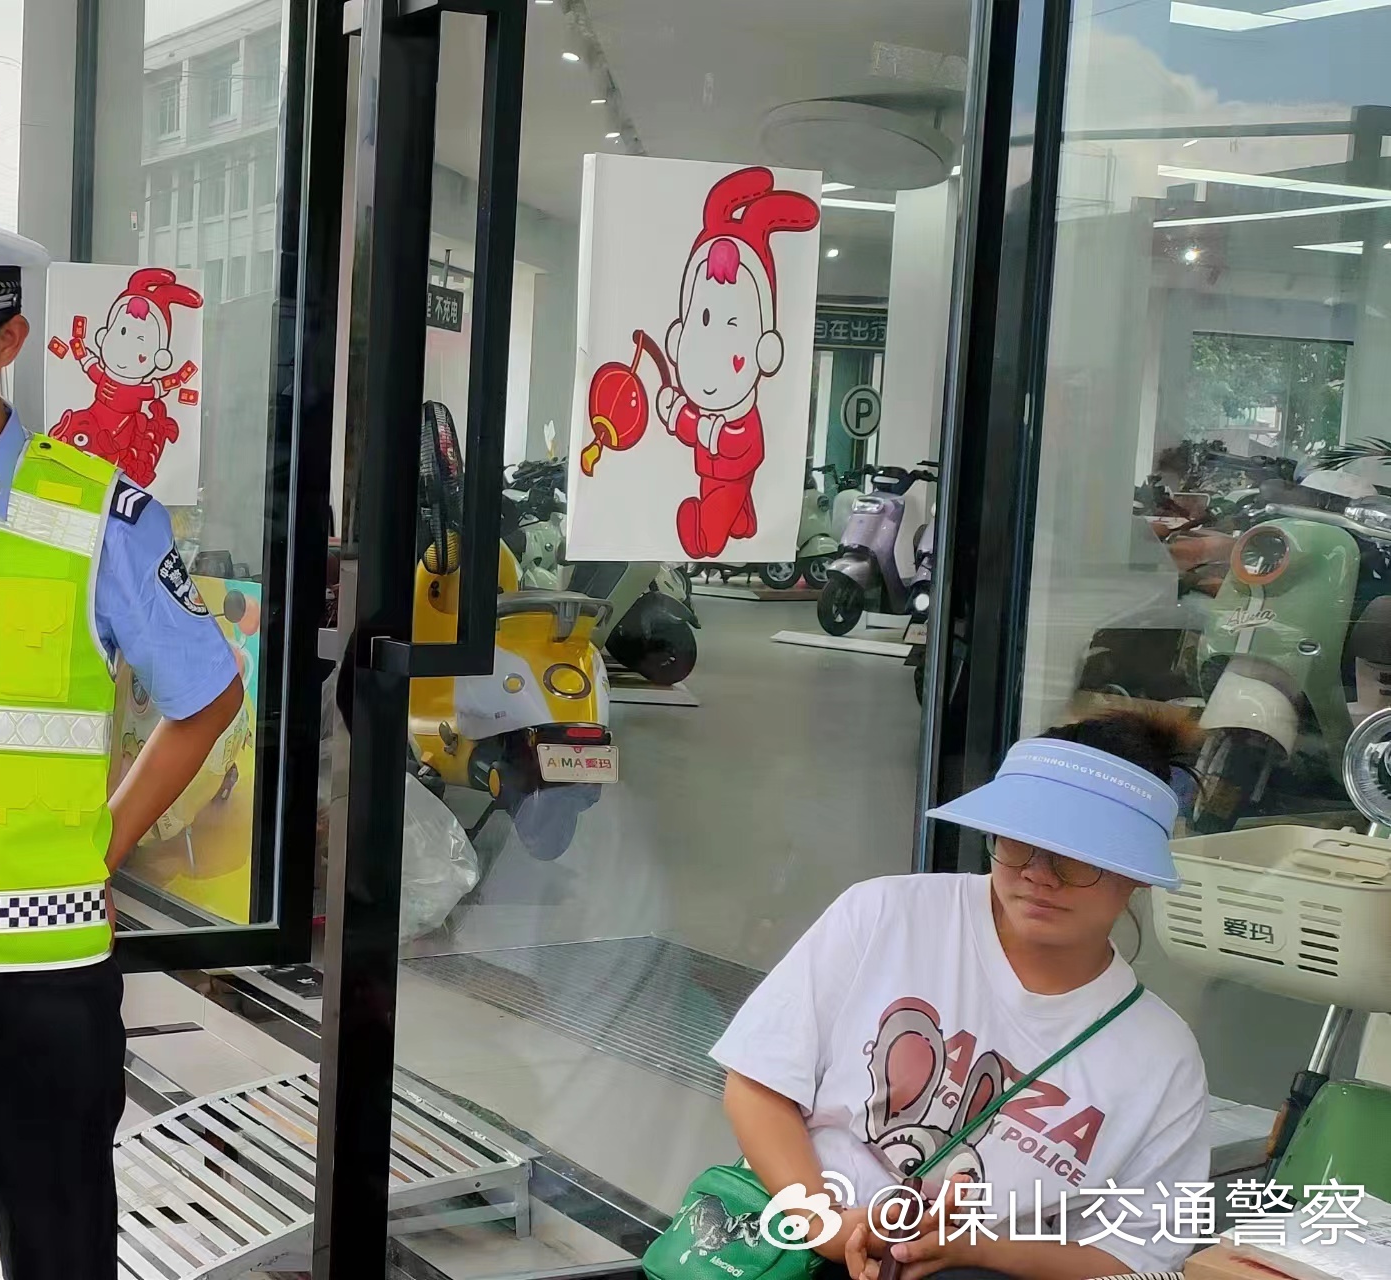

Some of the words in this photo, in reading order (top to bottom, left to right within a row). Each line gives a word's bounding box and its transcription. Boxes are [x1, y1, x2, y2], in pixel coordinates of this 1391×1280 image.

[855, 398, 874, 429] P
[1224, 917, 1274, 944] 爱玛
[1001, 1127, 1087, 1187] POLICE
